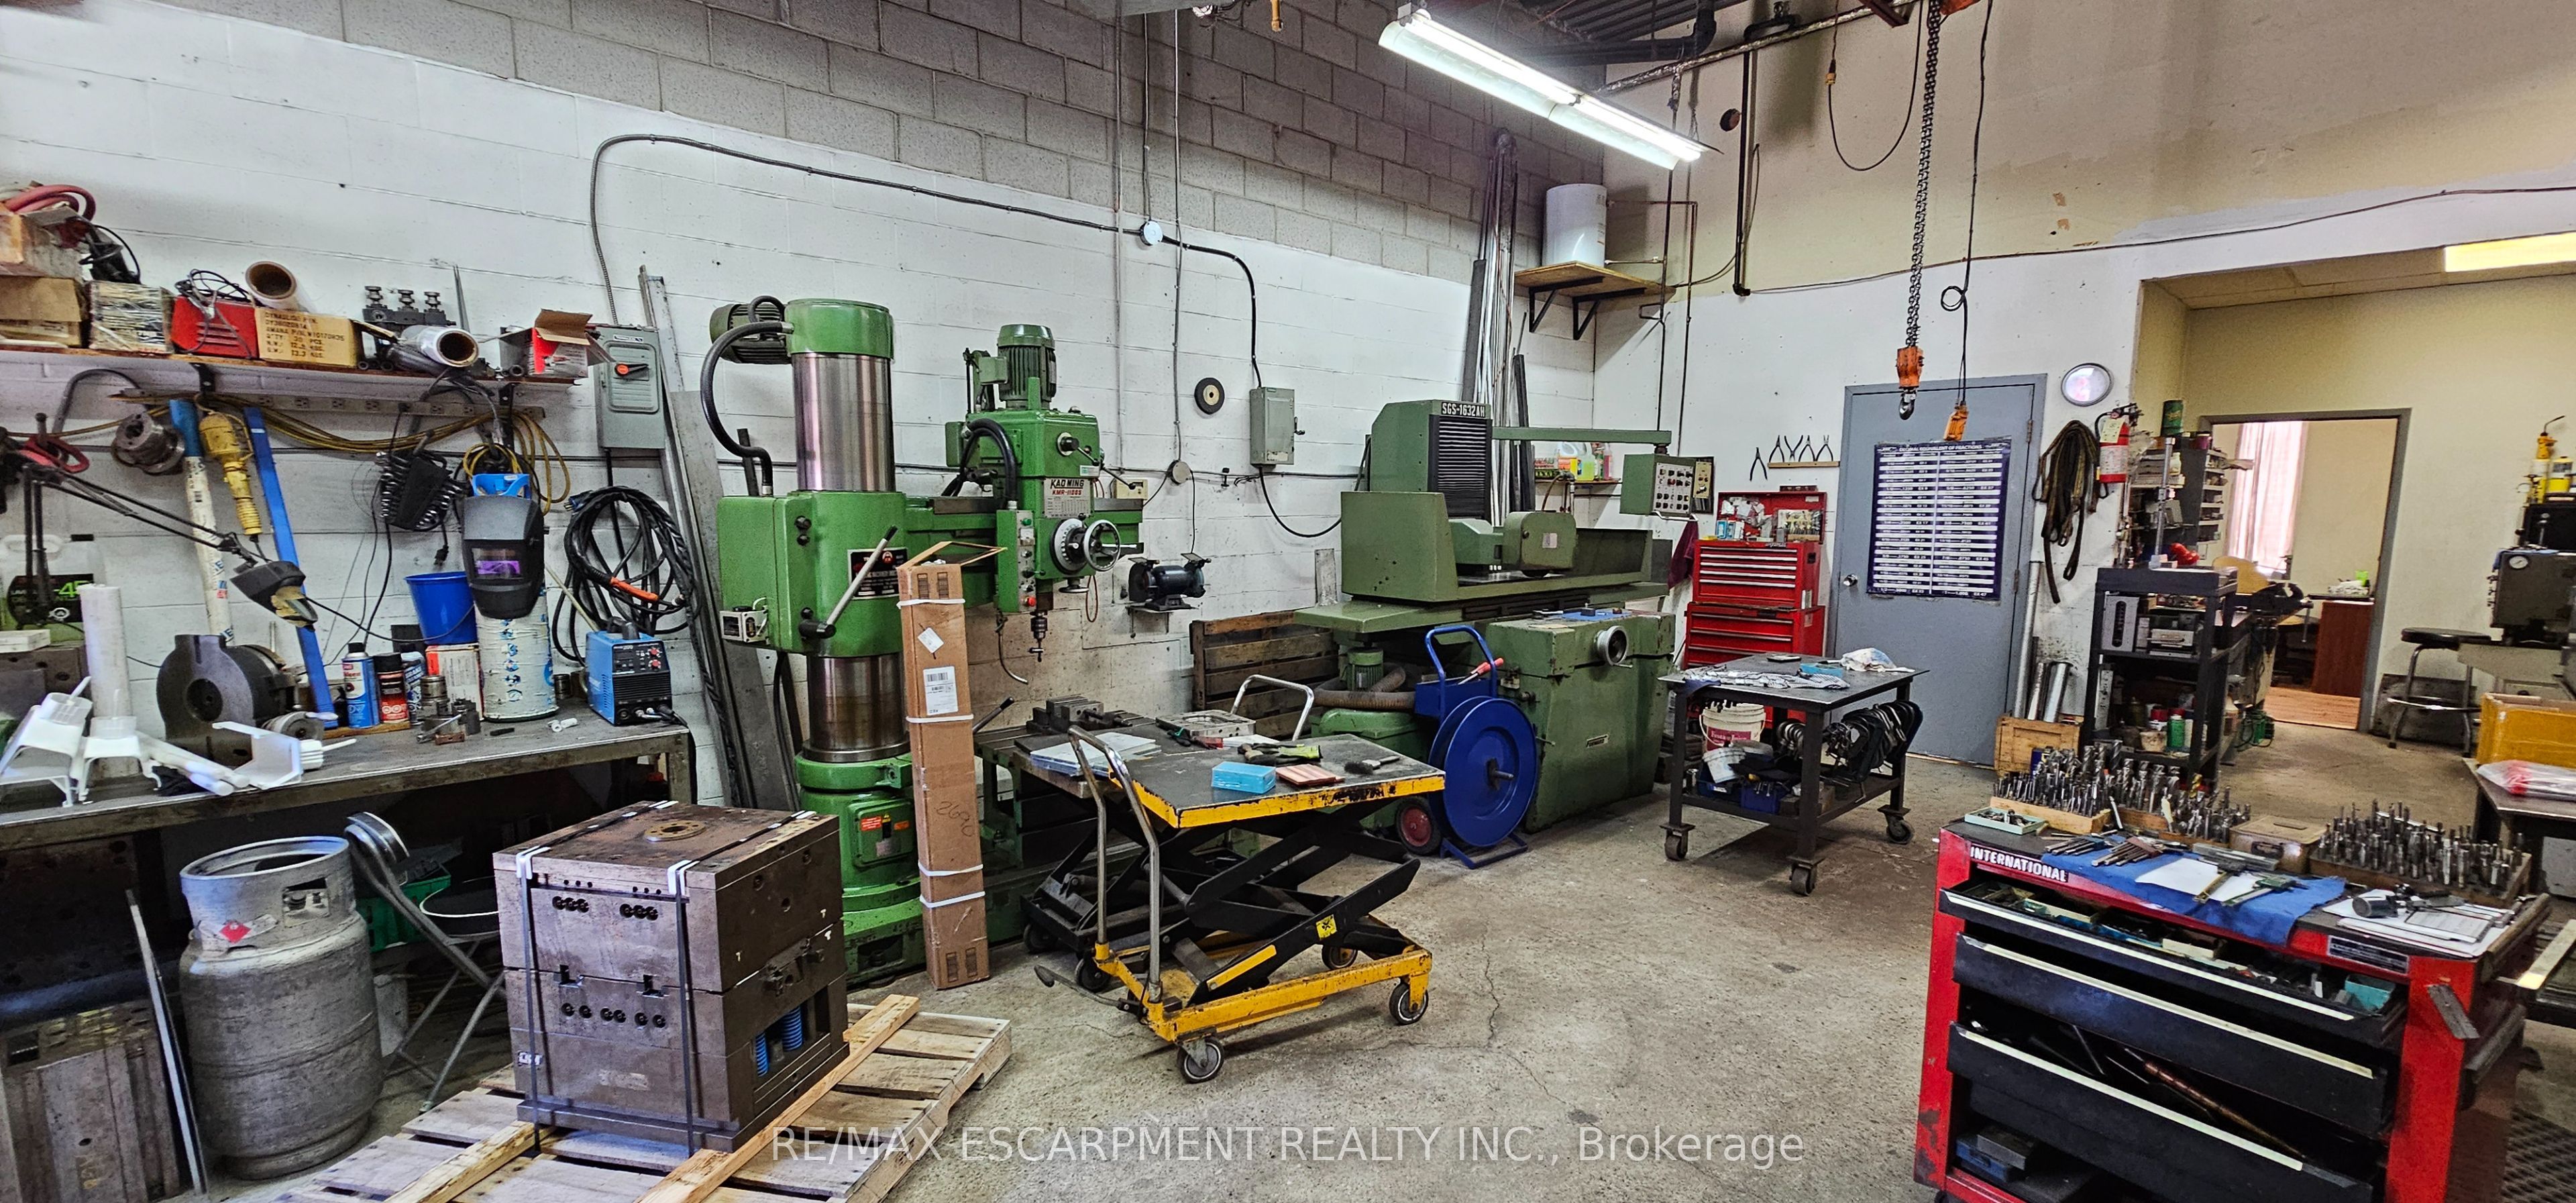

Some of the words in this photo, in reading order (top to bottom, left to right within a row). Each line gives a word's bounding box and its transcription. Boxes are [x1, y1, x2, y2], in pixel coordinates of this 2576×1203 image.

[1442, 403, 1485, 417] SGS-1632AH
[1050, 479, 1066, 489] KAO
[1067, 479, 1085, 487] MING
[1970, 846, 2067, 882] INTERNATIONAL
